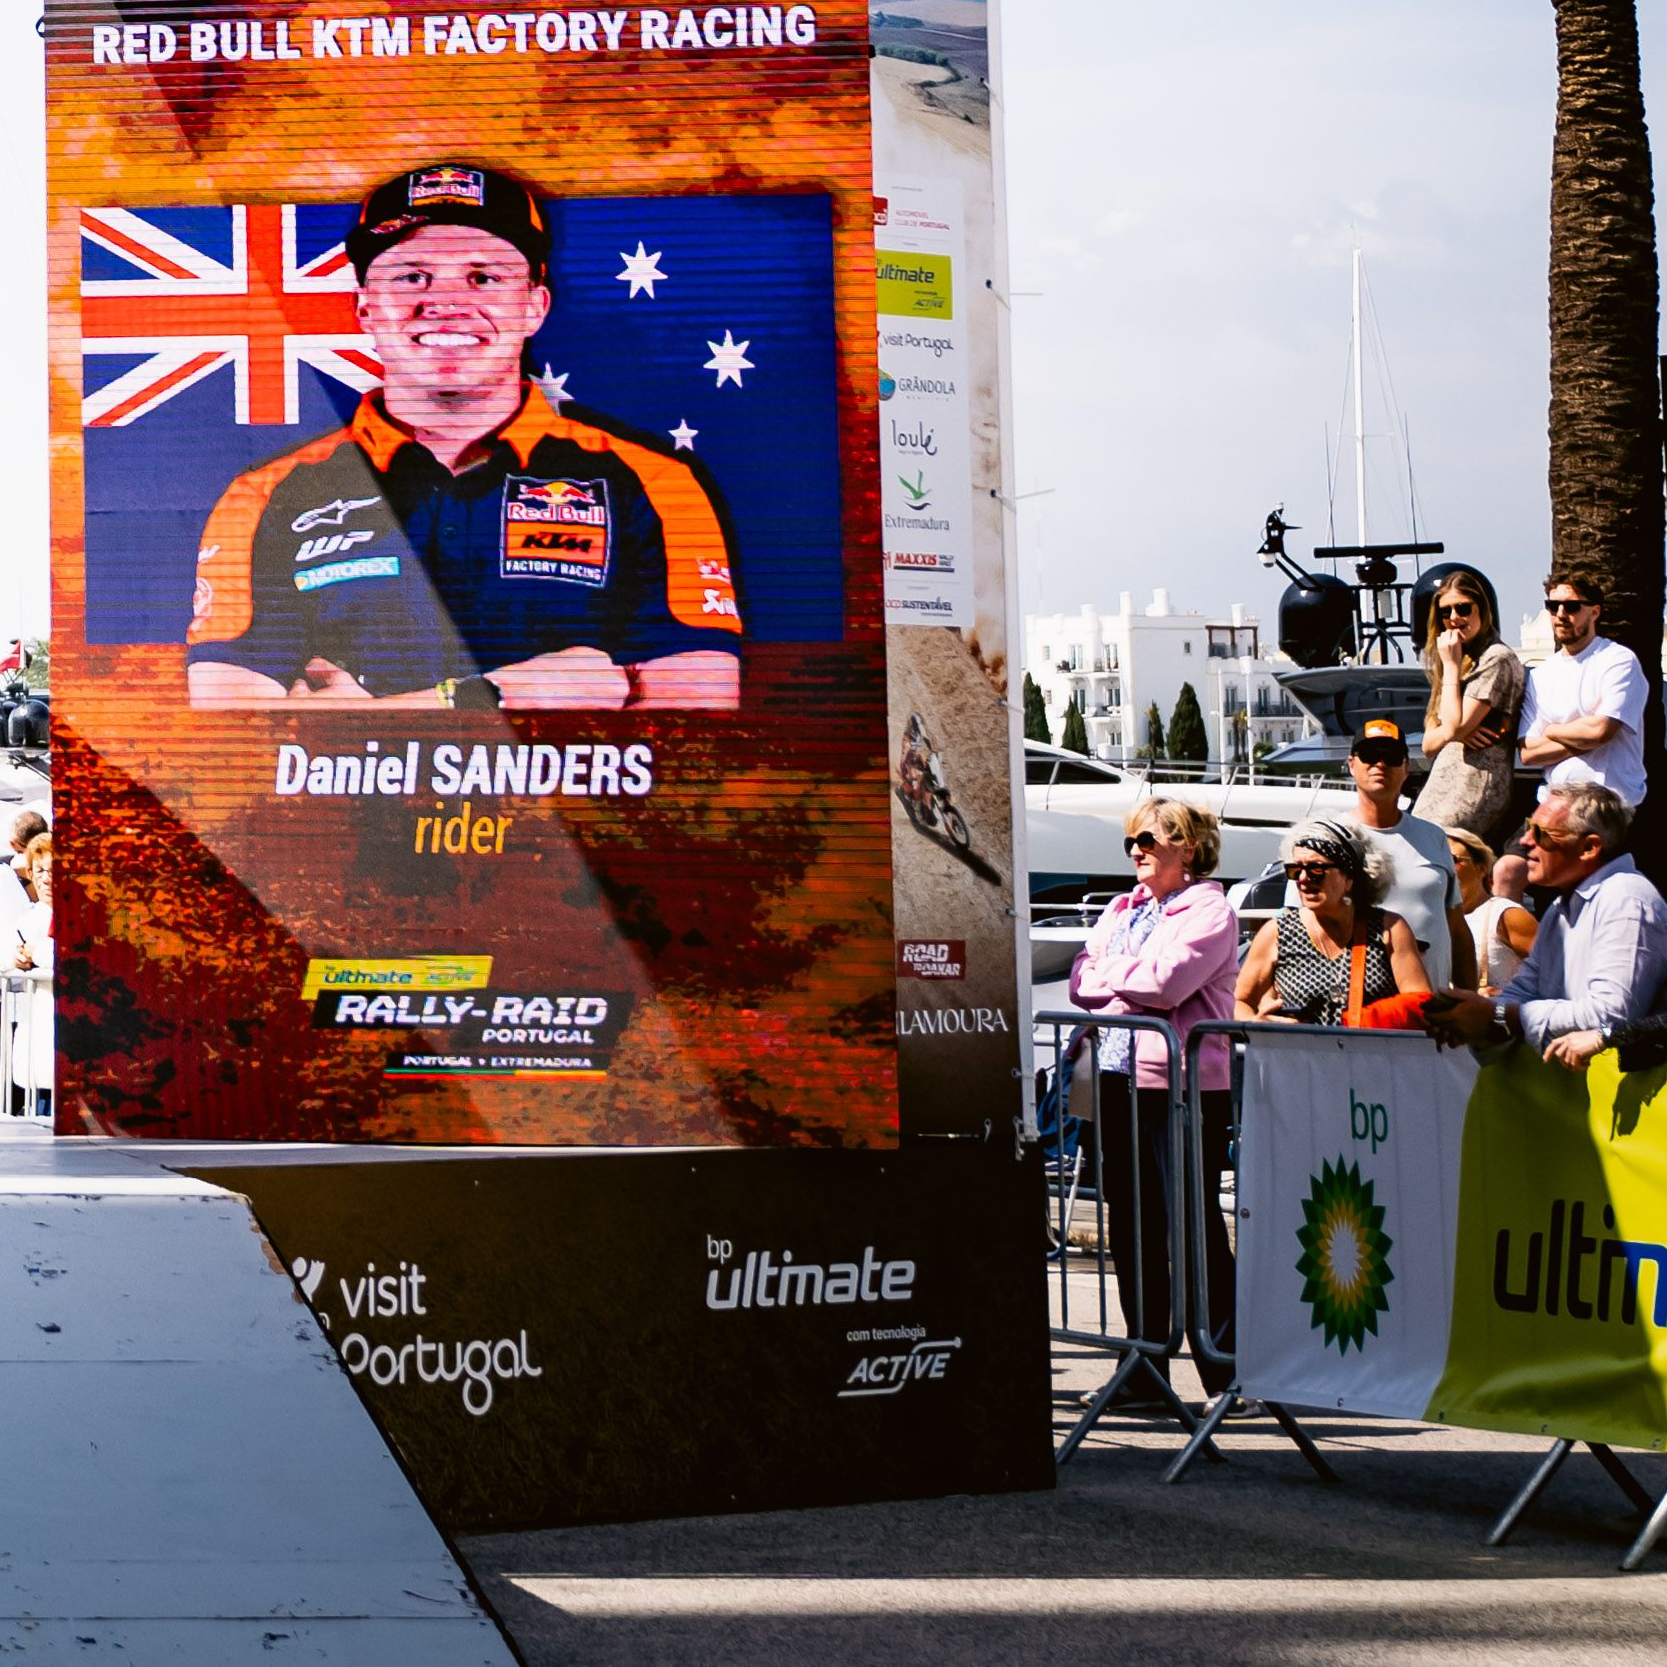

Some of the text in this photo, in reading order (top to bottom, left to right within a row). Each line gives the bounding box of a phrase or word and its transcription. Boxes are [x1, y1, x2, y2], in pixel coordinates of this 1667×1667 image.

[92, 5, 816, 65] RED BULL KTM FACTORY RACING
[905, 333, 955, 358] Portugal
[891, 418, 938, 456] loulé
[507, 501, 605, 526] Red Bull
[883, 513, 950, 531] Extremadura
[521, 531, 593, 555] KTM
[506, 560, 602, 581] FACTORY RACING
[894, 552, 937, 566] MAXXIS
[275, 740, 653, 795] Daniel SANDERS
[414, 801, 513, 855] rider
[902, 943, 949, 963] ROAD
[323, 969, 413, 985] ultimate
[334, 995, 608, 1026] RALLY-RAID
[895, 1007, 1009, 1035] ILAMOURA
[481, 1028, 595, 1045] PORTUGAL
[403, 1055, 593, 1069] PORTUGAL EXTREMADURA
[1349, 1088, 1389, 1155] bp
[706, 1234, 733, 1263] bp
[1493, 1197, 1667, 1329] ultim
[339, 1262, 427, 1319] visit
[705, 1247, 916, 1311] ultimate
[846, 1324, 927, 1342] com tecnologia
[847, 1352, 952, 1384] ACTIVE
